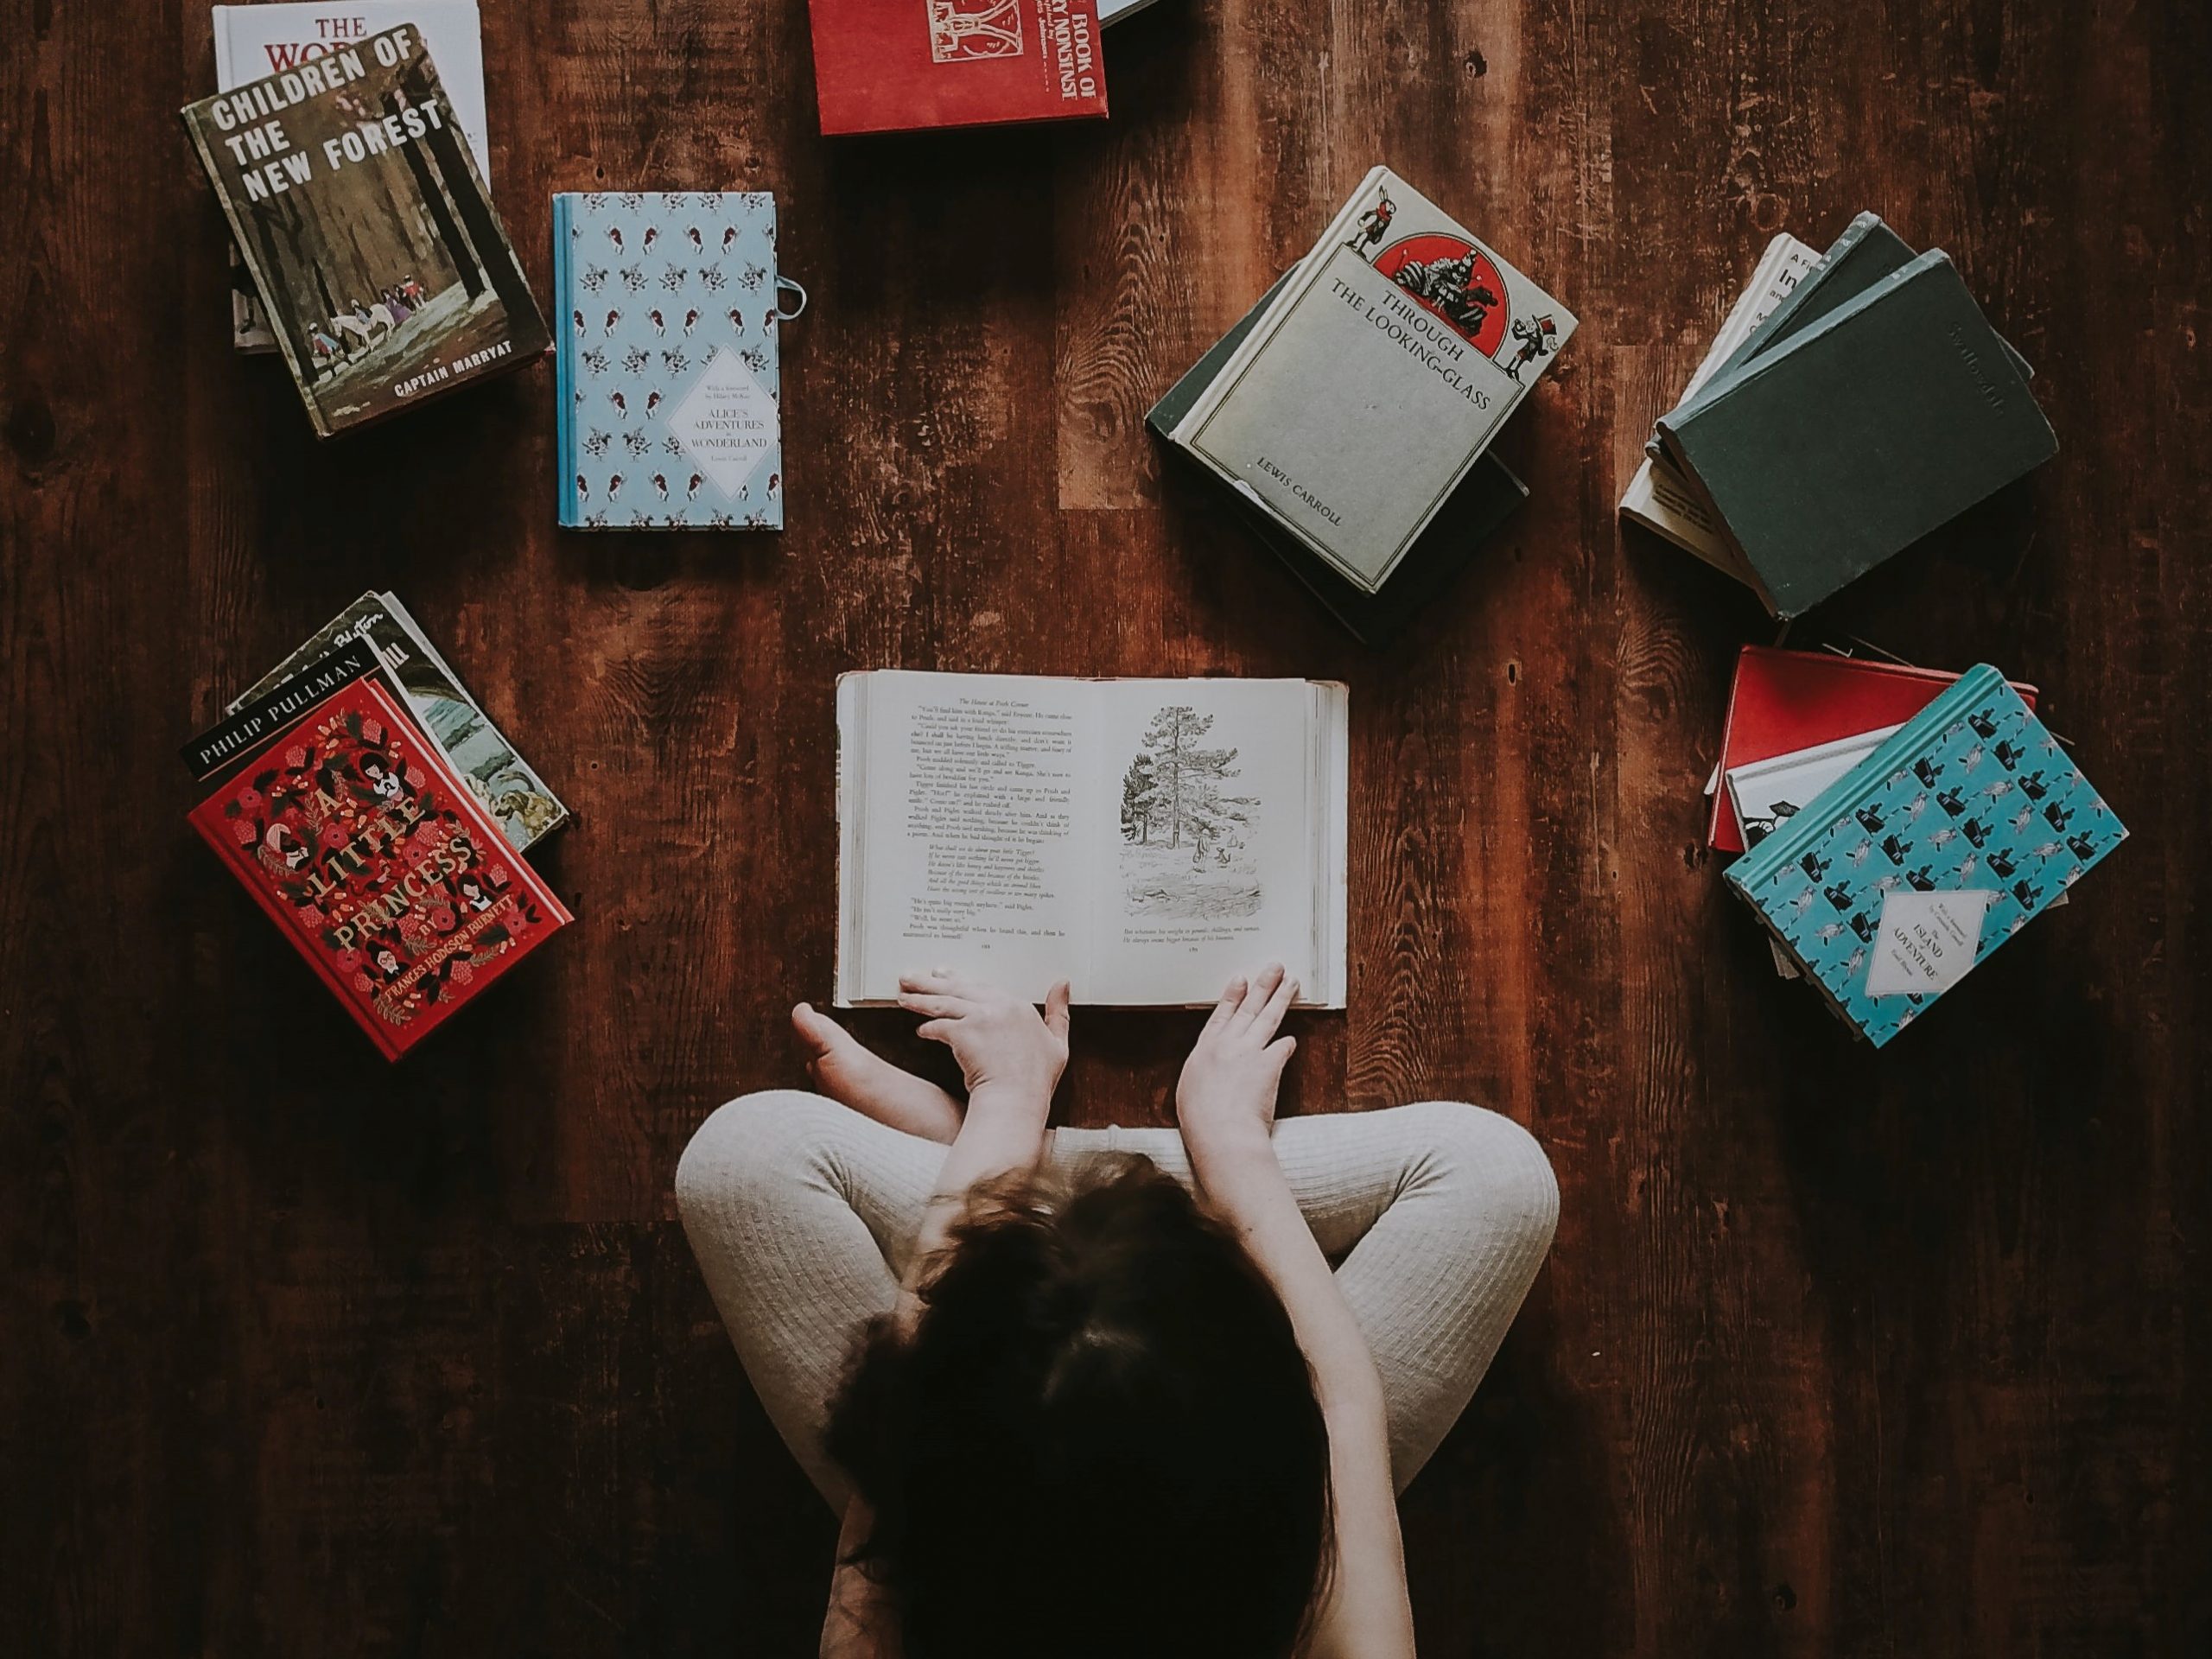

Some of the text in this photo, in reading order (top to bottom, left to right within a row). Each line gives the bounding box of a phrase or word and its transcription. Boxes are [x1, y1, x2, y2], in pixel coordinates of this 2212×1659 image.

[315, 17, 367, 37] THE
[1071, 14, 1096, 99] BOOK OF
[212, 48, 365, 130] CHILDREN
[372, 29, 412, 67] OF
[1054, 18, 1077, 101] NONSENSE
[225, 119, 290, 166] THE
[242, 150, 312, 202] NEW
[322, 99, 442, 171] FOREST
[1790, 254, 1799, 263] A
[1331, 277, 1491, 410] THE LOOKING-GLASS
[1382, 290, 1465, 362] THROUGH
[394, 340, 512, 397] CAPTAIN MARRYAT
[691, 438, 767, 448] WONDERLAND
[694, 420, 765, 430] ADVENTURES
[709, 409, 749, 419] ALICE'S
[1256, 457, 1341, 526] LEWIS CARROLL
[200, 716, 262, 765] PHILIP
[268, 654, 361, 721] PULLMAN
[314, 788, 346, 817] A
[307, 797, 425, 897] LITTLE
[334, 837, 471, 954] PRINCESS
[419, 918, 438, 936] BY
[385, 894, 513, 1001] FRANCES HODGSON BURNETT
[1893, 927, 1939, 981] ADVENTURE
[1913, 924, 1943, 958] ISLAND
